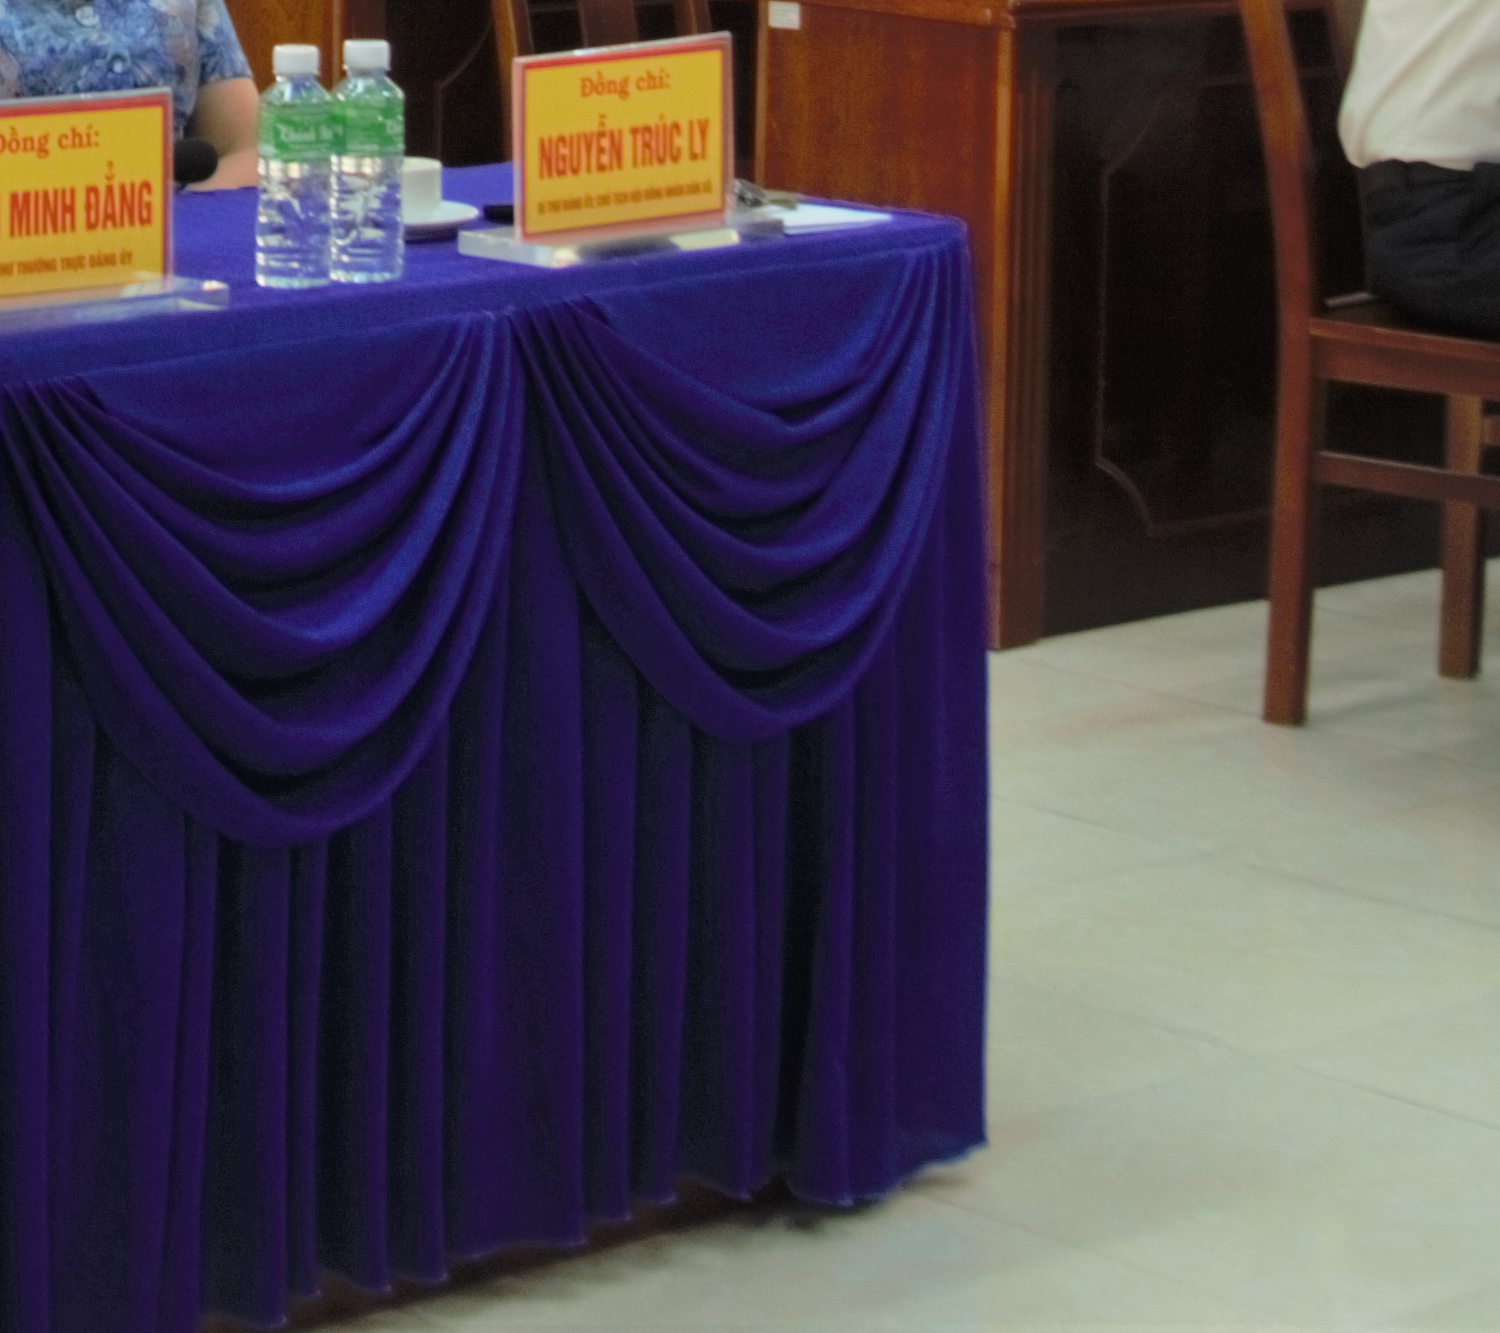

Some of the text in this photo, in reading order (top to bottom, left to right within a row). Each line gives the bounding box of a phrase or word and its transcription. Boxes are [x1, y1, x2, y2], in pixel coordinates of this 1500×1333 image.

[579, 67, 671, 101] Đồng chí:
[58, 123, 100, 150] chí:
[538, 113, 710, 181] NGUYỄN TRÚC LY
[9, 186, 76, 239] MINH
